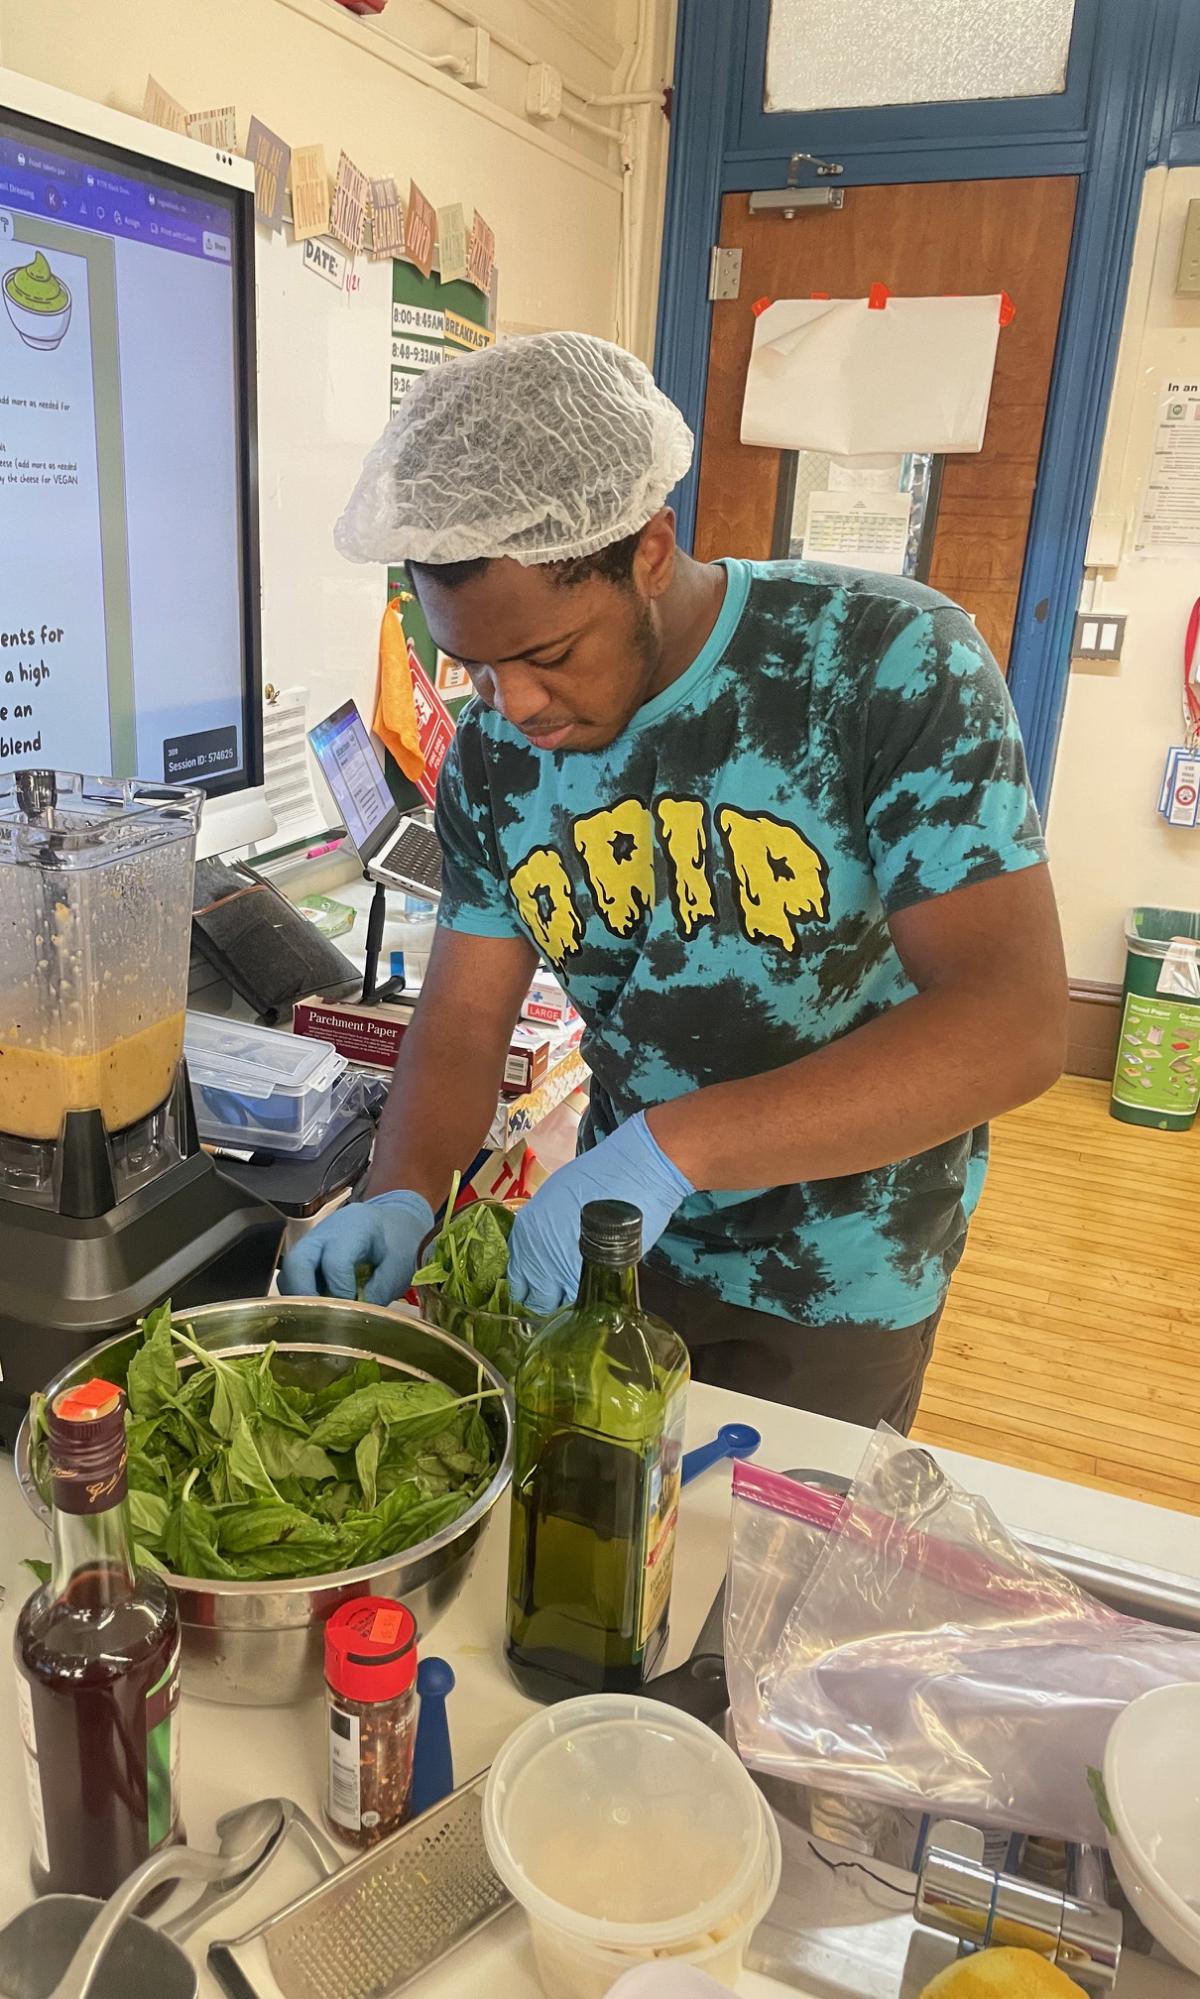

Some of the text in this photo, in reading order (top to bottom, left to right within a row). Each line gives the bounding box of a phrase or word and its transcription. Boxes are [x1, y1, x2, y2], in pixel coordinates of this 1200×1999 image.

[332, 187, 363, 249] STRONG
[407, 211, 432, 264] LOVED
[306, 240, 338, 277] DATE:
[393, 307, 444, 331] 8:00-8:45AM
[445, 317, 490, 348] BREAKFAST
[391, 342, 441, 366] 8:48-9:33AM
[1168, 383, 1179, 392] In
[12, 399, 27, 407] more
[29, 400, 37, 408] as
[39, 400, 59, 410] needed
[60, 401, 70, 411] for
[31, 462, 46, 470] more
[57, 462, 77, 471] needed
[8, 473, 18, 483] the
[20, 474, 39, 484] cheese
[41, 475, 51, 484] for
[53, 474, 78, 485] VEGAN
[0, 624, 64, 647] ents for
[5, 658, 50, 687] a high
[14, 704, 32, 718] an
[0, 730, 41, 758] blend
[168, 757, 196, 773] Session
[197, 754, 207, 766] ID:
[309, 1010, 398, 1038] Parchment Paper
[529, 1006, 560, 1021] LARGE
